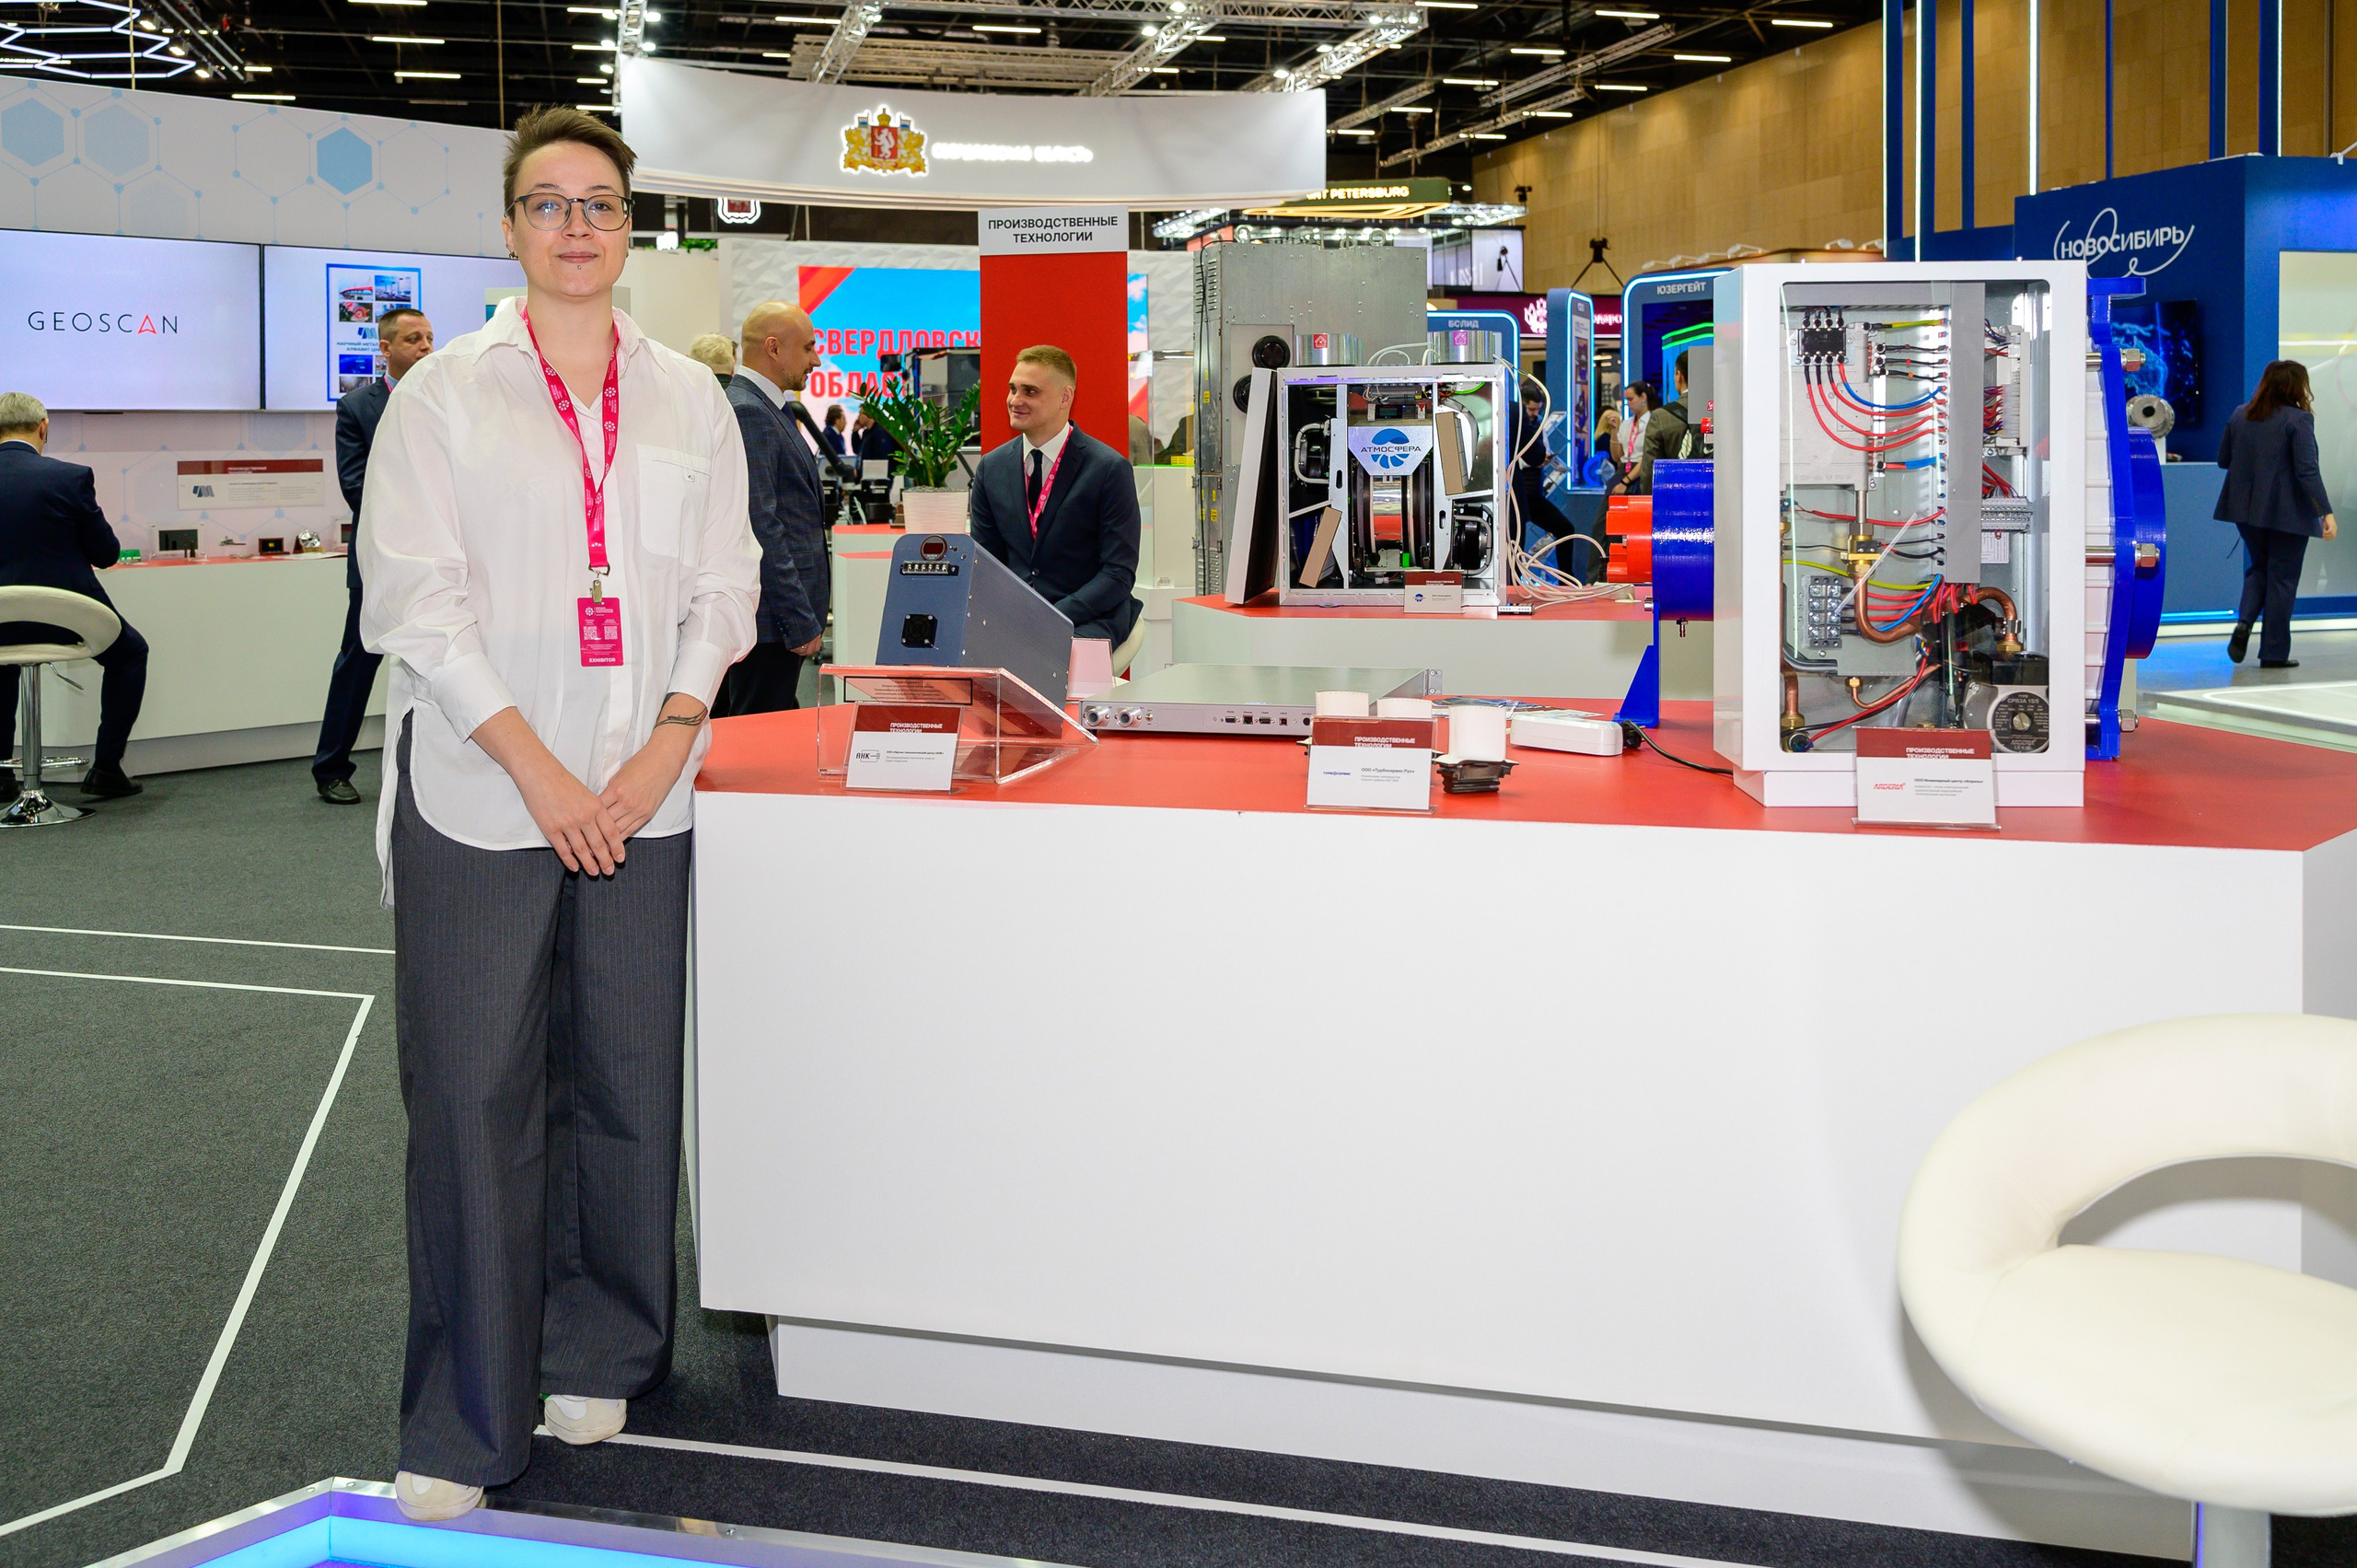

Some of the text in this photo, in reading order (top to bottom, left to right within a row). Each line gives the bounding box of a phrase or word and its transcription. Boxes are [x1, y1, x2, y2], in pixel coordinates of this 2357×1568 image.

[1329, 186, 1410, 200] PETERSBURG
[988, 216, 1118, 229] ПРОИЗВОДСТВЕННЫЕ
[1013, 232, 1093, 243] ТЕХНОЛОГИИ
[2061, 226, 2185, 259] НОВОСИБИРЬ
[1656, 281, 1706, 295] ЮЗЕРГЕЙТ
[28, 311, 178, 334] GEOSCAN
[810, 371, 906, 398] ОБЛАС
